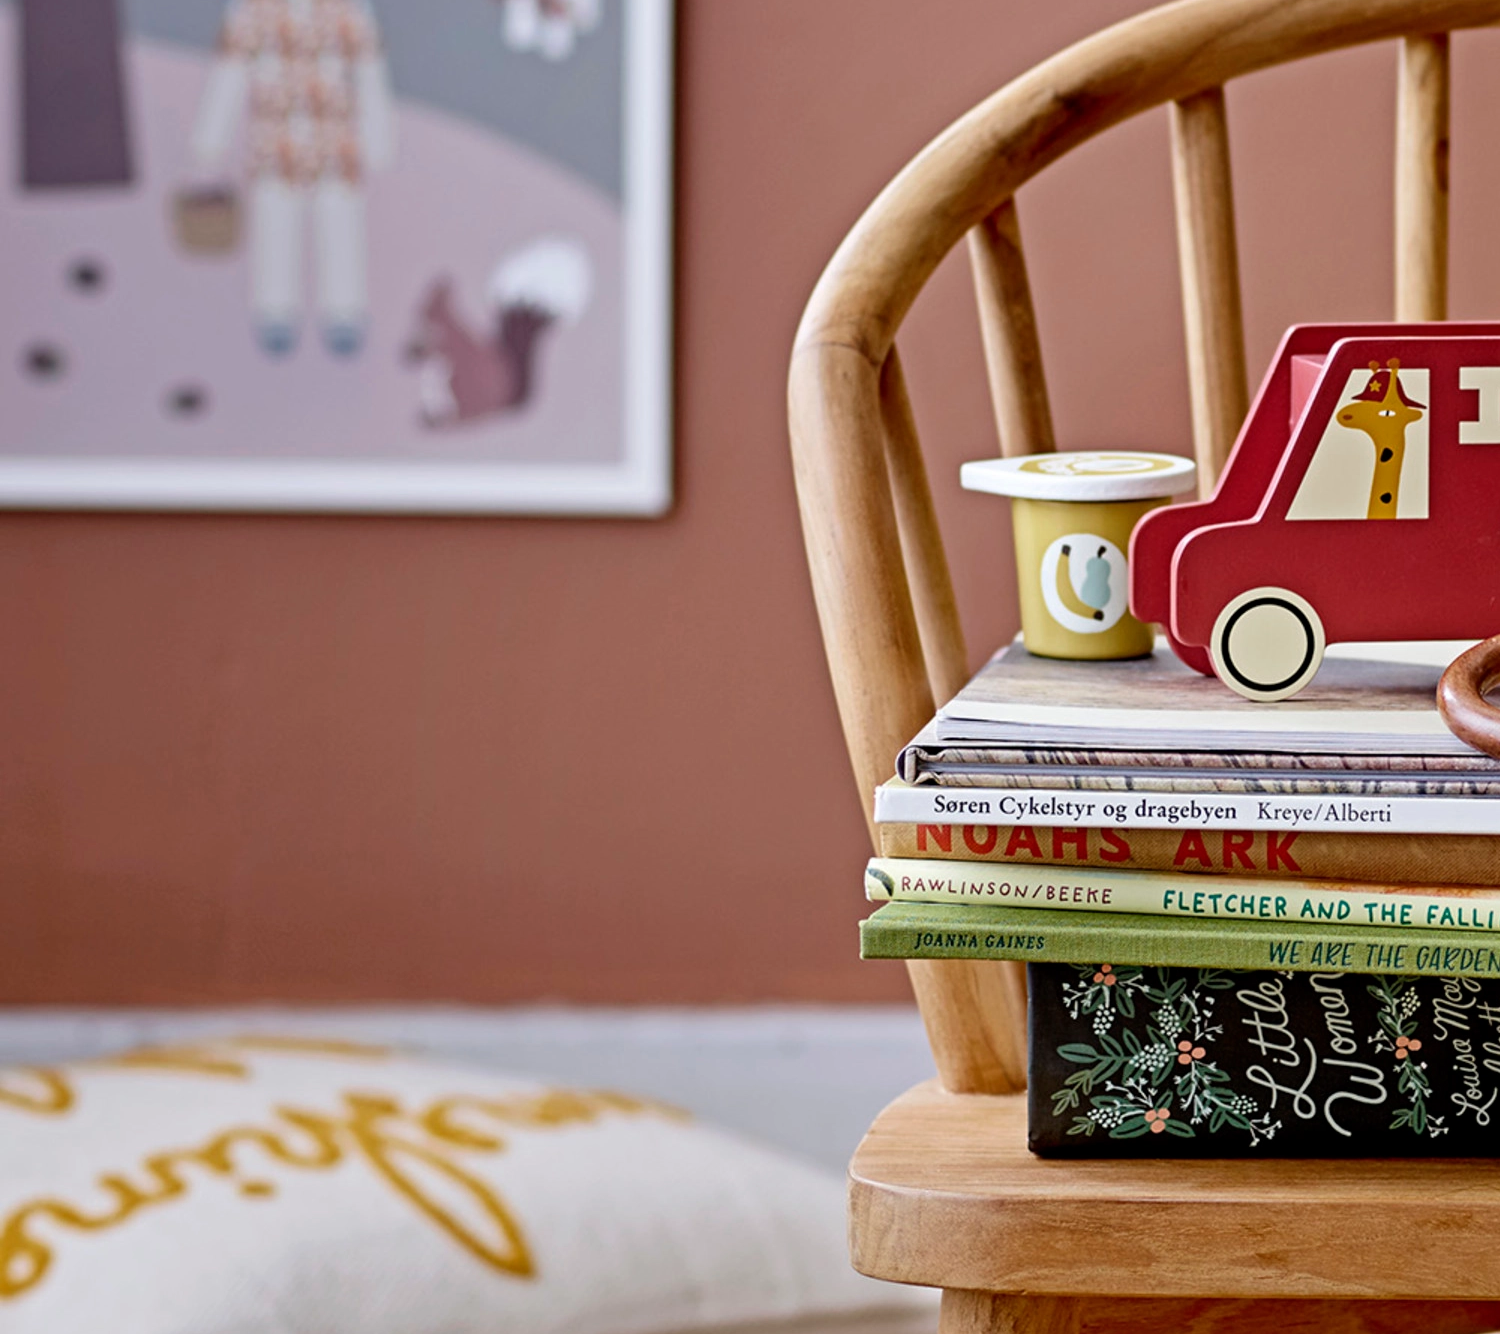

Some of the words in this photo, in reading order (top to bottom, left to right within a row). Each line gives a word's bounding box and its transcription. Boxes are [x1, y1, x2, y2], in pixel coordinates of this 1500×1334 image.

[934, 794, 991, 814] Søren
[999, 796, 1097, 823] Cykelstyr
[1102, 803, 1128, 823] og
[1134, 798, 1237, 825] dragebyen
[1257, 801, 1392, 827] Kreye/Alberti
[916, 824, 1132, 862] NOAHS
[1173, 829, 1302, 872] ARK
[901, 875, 1113, 905] RAWLINSON/BEEKE
[1162, 889, 1288, 918] FLETCHER
[1300, 898, 1351, 920] AND
[1363, 902, 1413, 925] THE
[914, 932, 979, 950] JOANNA
[984, 934, 1046, 951] GAINES
[1269, 940, 1304, 965] WE
[1310, 941, 1356, 966] ARE
[1366, 943, 1409, 968] THE
[1235, 978, 1318, 1119] Little
[1309, 972, 1388, 1137] Women
[1450, 1038, 1499, 1127] Louisa
